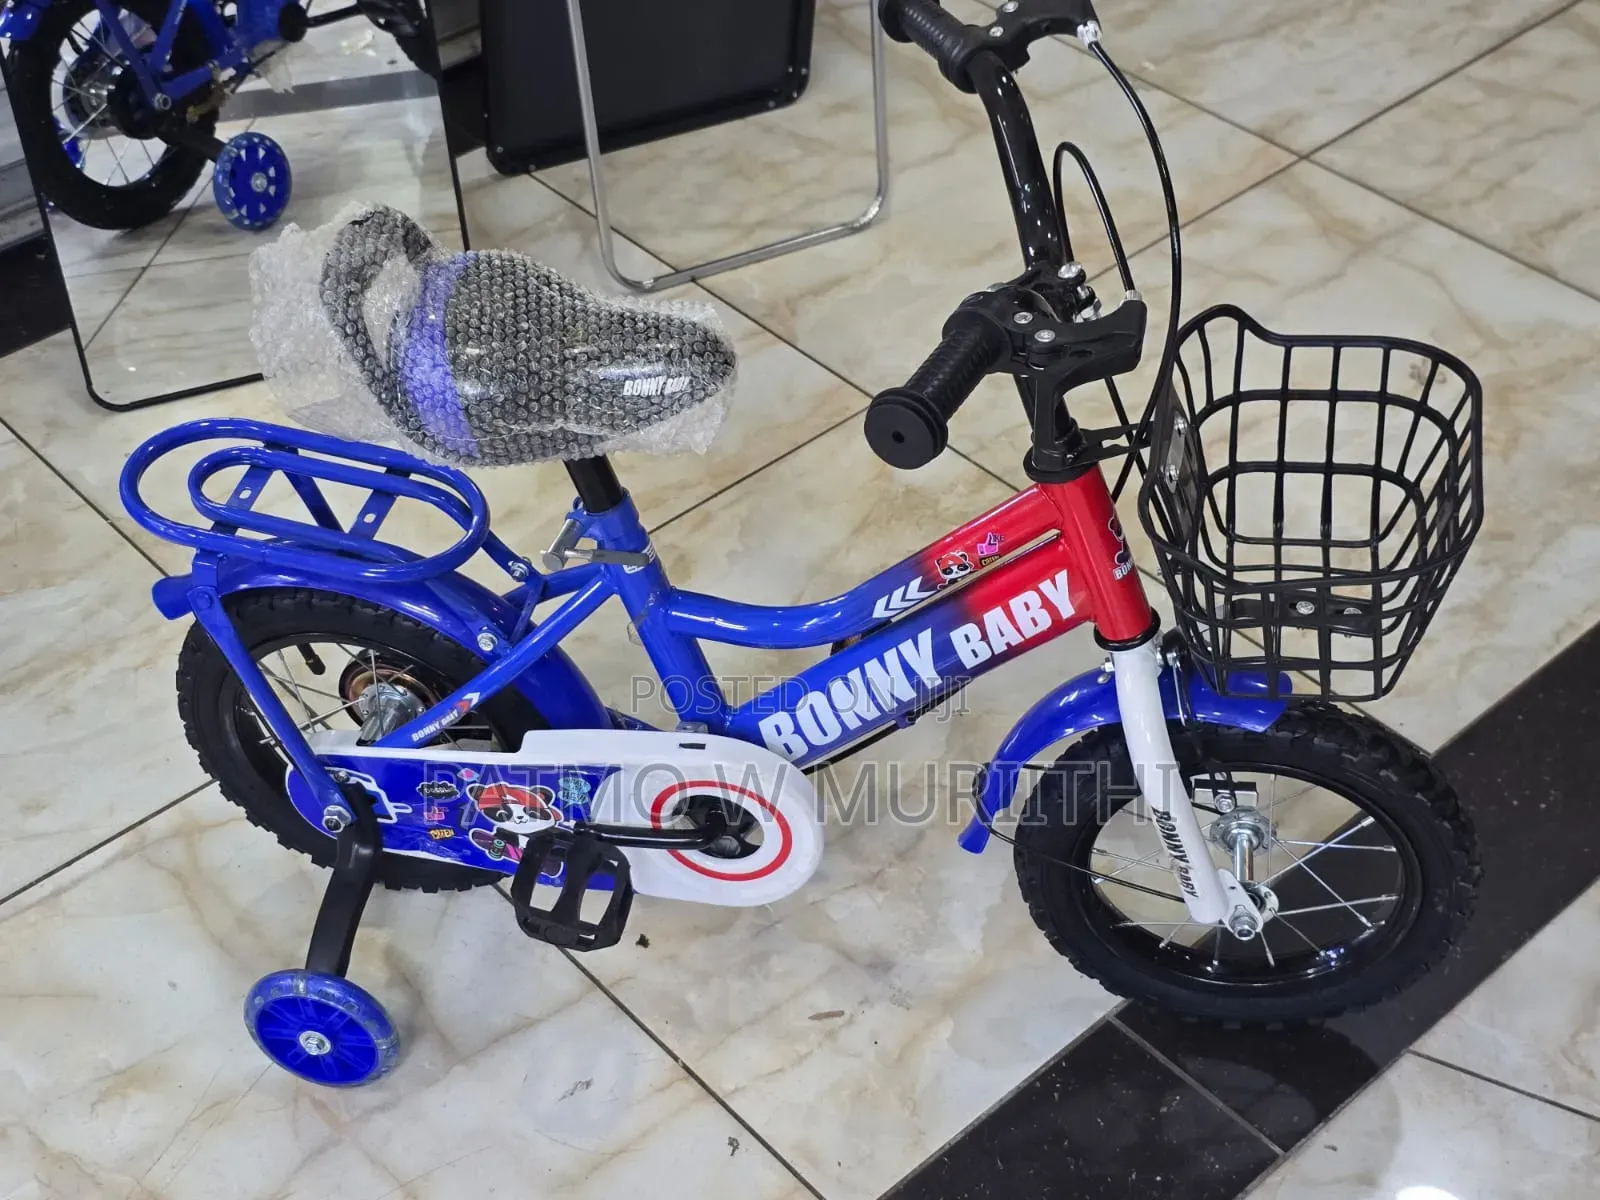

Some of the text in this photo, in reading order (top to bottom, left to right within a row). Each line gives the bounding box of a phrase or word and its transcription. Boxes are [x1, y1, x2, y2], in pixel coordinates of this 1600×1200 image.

[622, 376, 667, 397] BONNY
[758, 569, 1075, 765] BONNY BABY
[411, 721, 440, 742] BONNY
[1151, 805, 1199, 898] BONNY BABY
